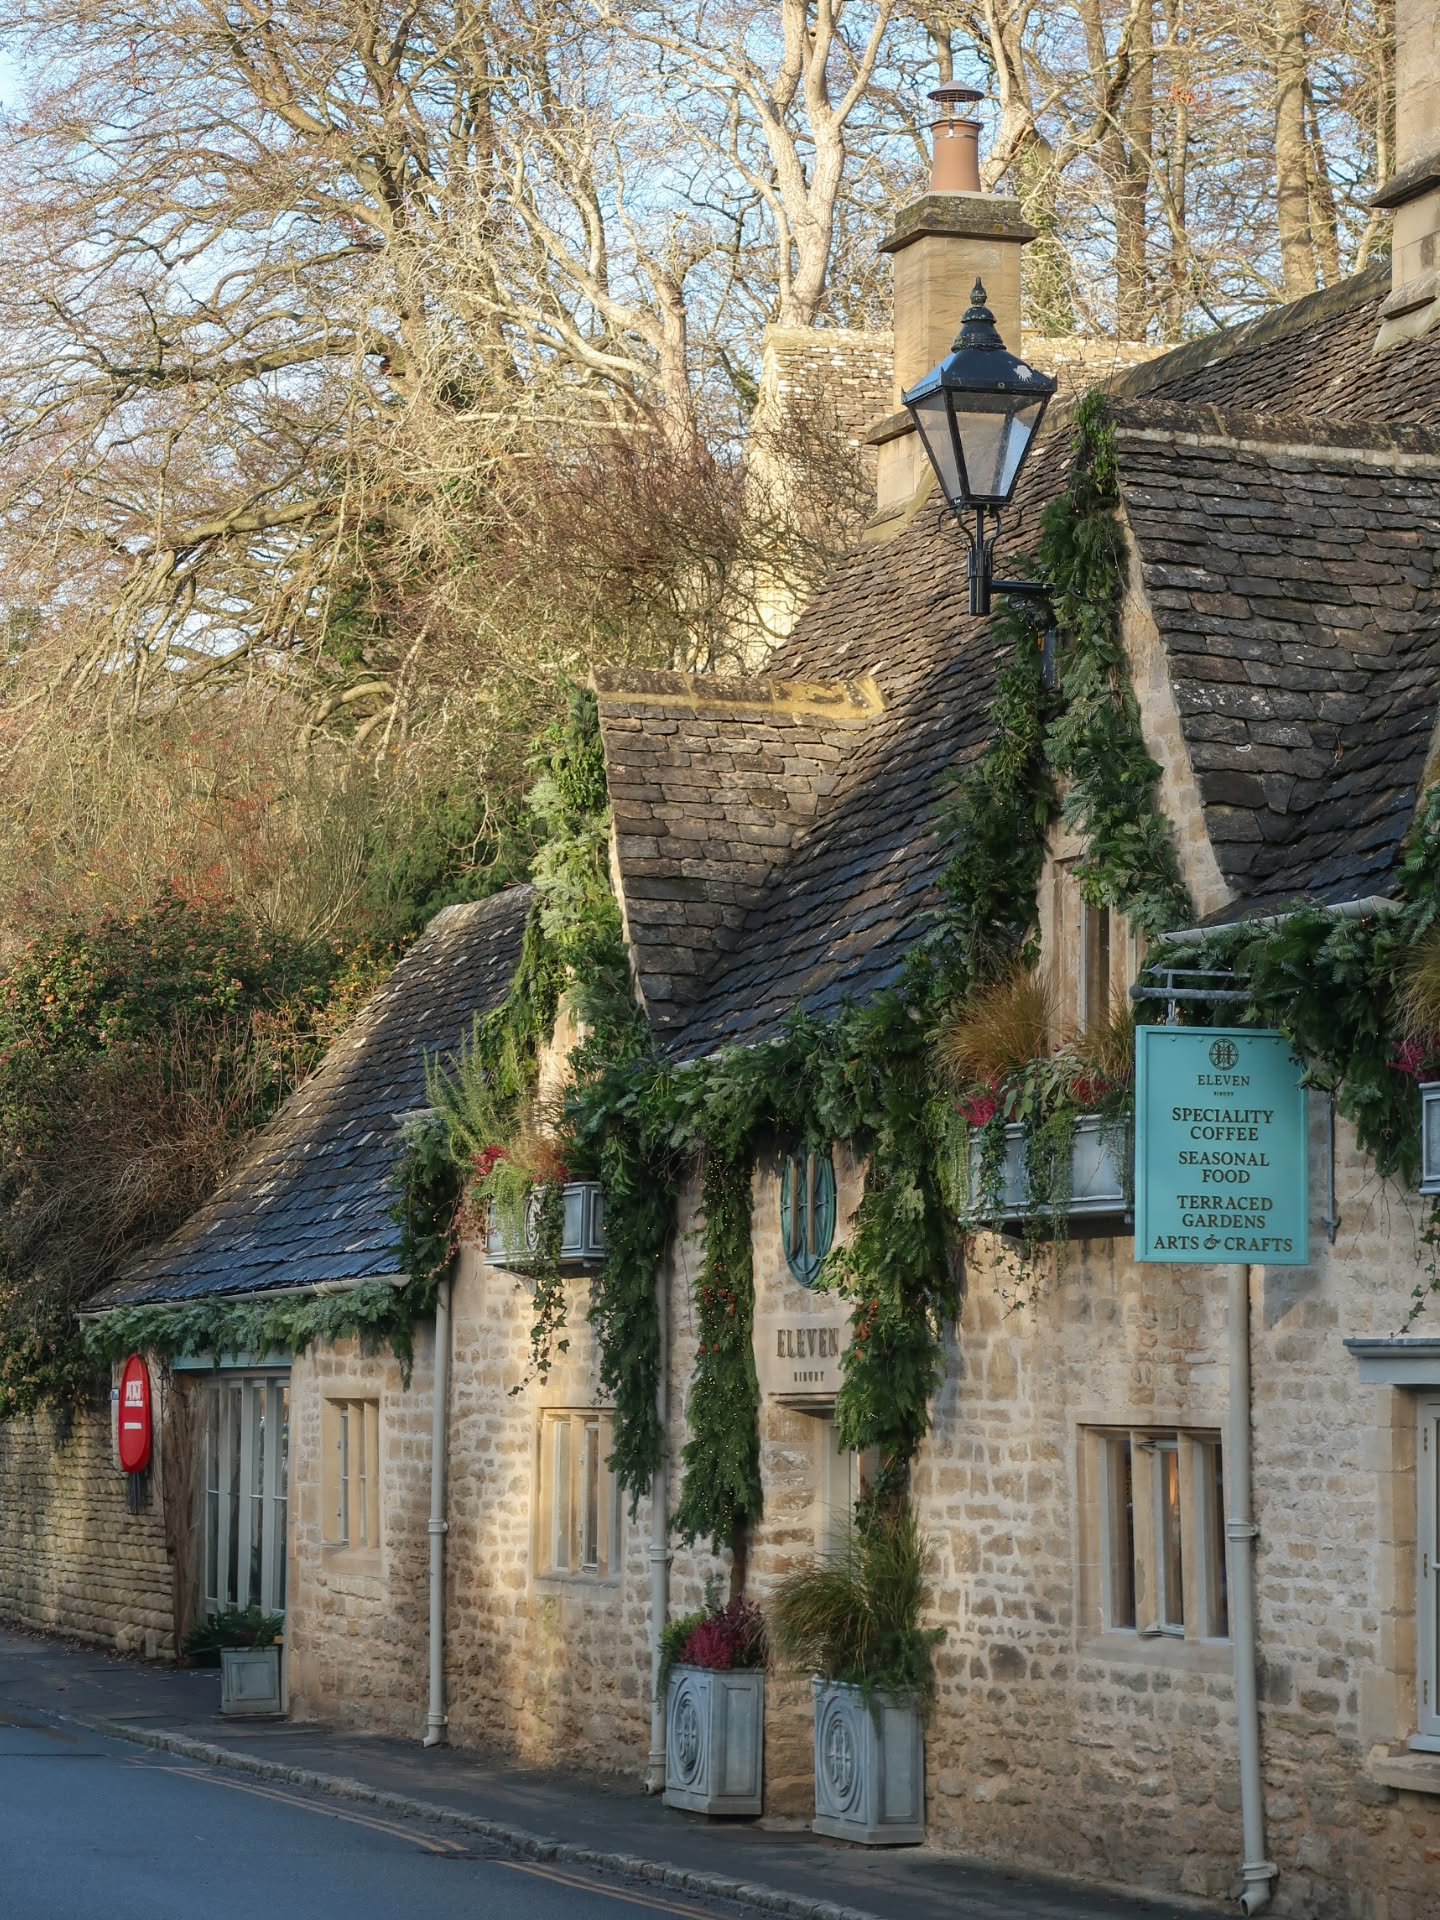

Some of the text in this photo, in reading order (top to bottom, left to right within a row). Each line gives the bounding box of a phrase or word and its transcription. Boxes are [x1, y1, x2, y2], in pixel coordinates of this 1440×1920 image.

[1197, 1075, 1250, 1086] ELEVEN
[1172, 1107, 1274, 1124] SPECIALITY
[1190, 1126, 1259, 1141] COFFEE
[1178, 1151, 1270, 1167] SEASONAL
[1201, 1169, 1250, 1184] FOOD
[1177, 1195, 1273, 1211] TERRACED
[1182, 1214, 1266, 1229] GARDENS
[1154, 1234, 1293, 1252] ARTS & CRAFTS
[776, 1328, 839, 1358] ELEVEN
